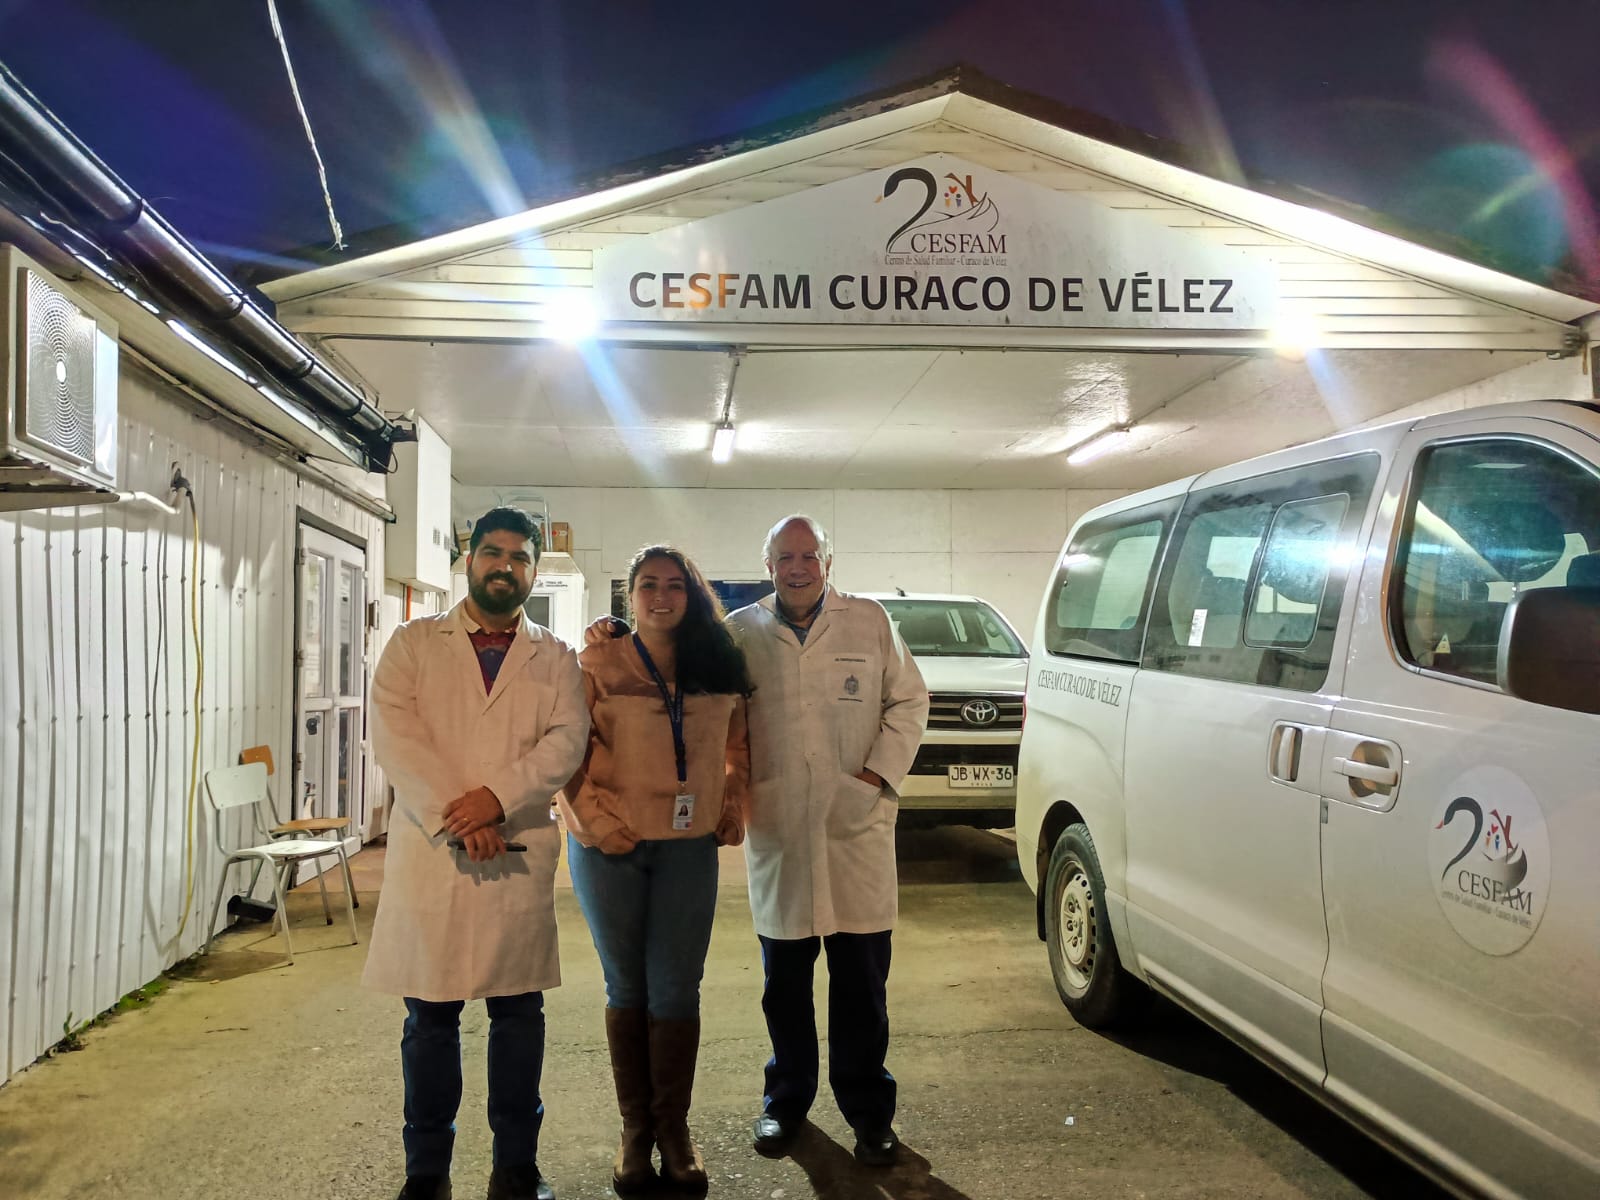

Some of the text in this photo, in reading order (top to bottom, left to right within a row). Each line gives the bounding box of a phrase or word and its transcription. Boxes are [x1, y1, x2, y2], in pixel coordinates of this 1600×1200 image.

[910, 233, 1007, 254] CESFAM
[629, 271, 1234, 314] CESFAM CURACO DE VÉLEZ
[1085, 678, 1098, 700] DE
[1458, 869, 1533, 915] CESFAM
